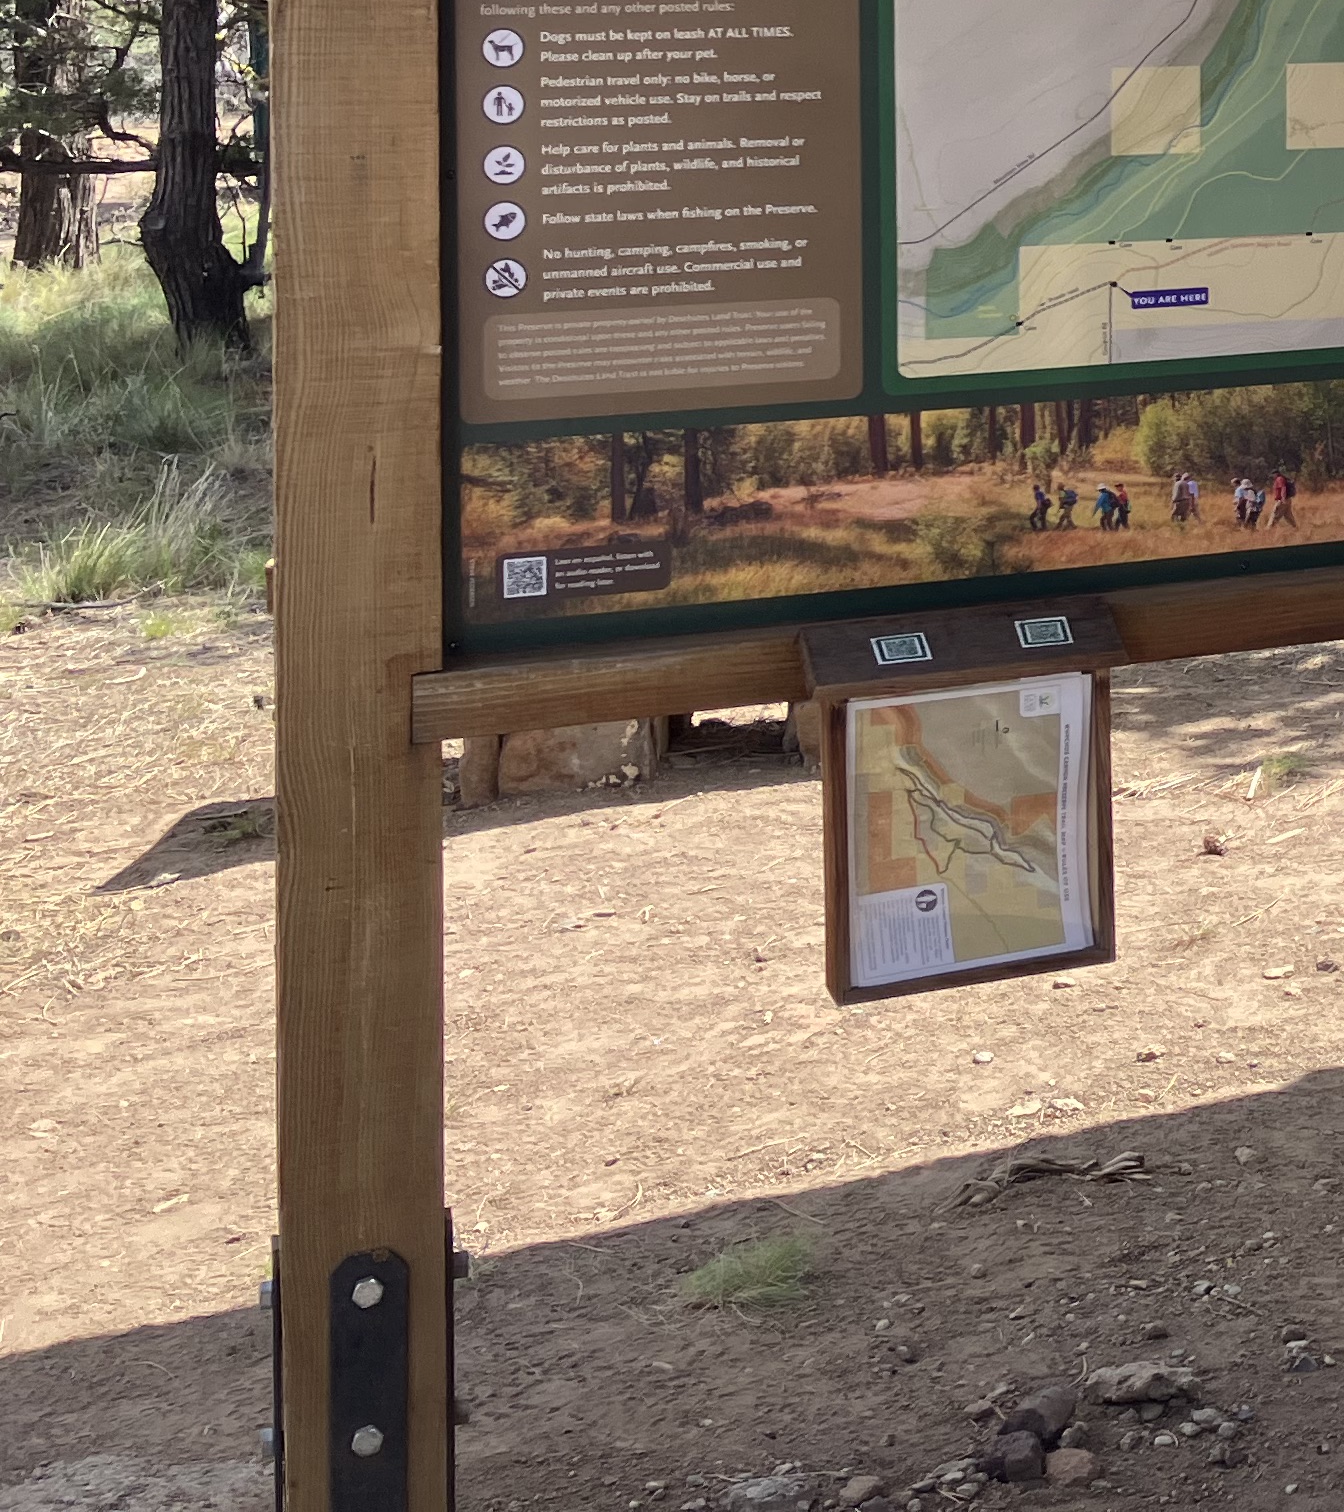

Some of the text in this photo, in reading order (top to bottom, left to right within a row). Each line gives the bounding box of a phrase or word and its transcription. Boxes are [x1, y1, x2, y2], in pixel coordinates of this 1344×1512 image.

[539, 32, 573, 44] Dogs
[575, 32, 607, 41] must
[608, 30, 625, 40] be
[626, 30, 653, 42] kept
[673, 28, 706, 39] leash
[707, 28, 724, 38] AT
[725, 28, 750, 38] ALL
[749, 27, 795, 37] TIMES.
[540, 48, 719, 62] Please clean up after your pet.
[542, 213, 582, 224] Follow
[584, 213, 614, 222] state
[616, 210, 645, 220] laws
[646, 209, 680, 219] when
[681, 207, 723, 220] fishing
[742, 205, 763, 215] the
[765, 205, 819, 214] Preserve.
[1157, 295, 1178, 303] ARE
[1179, 293, 1207, 302] HERE
